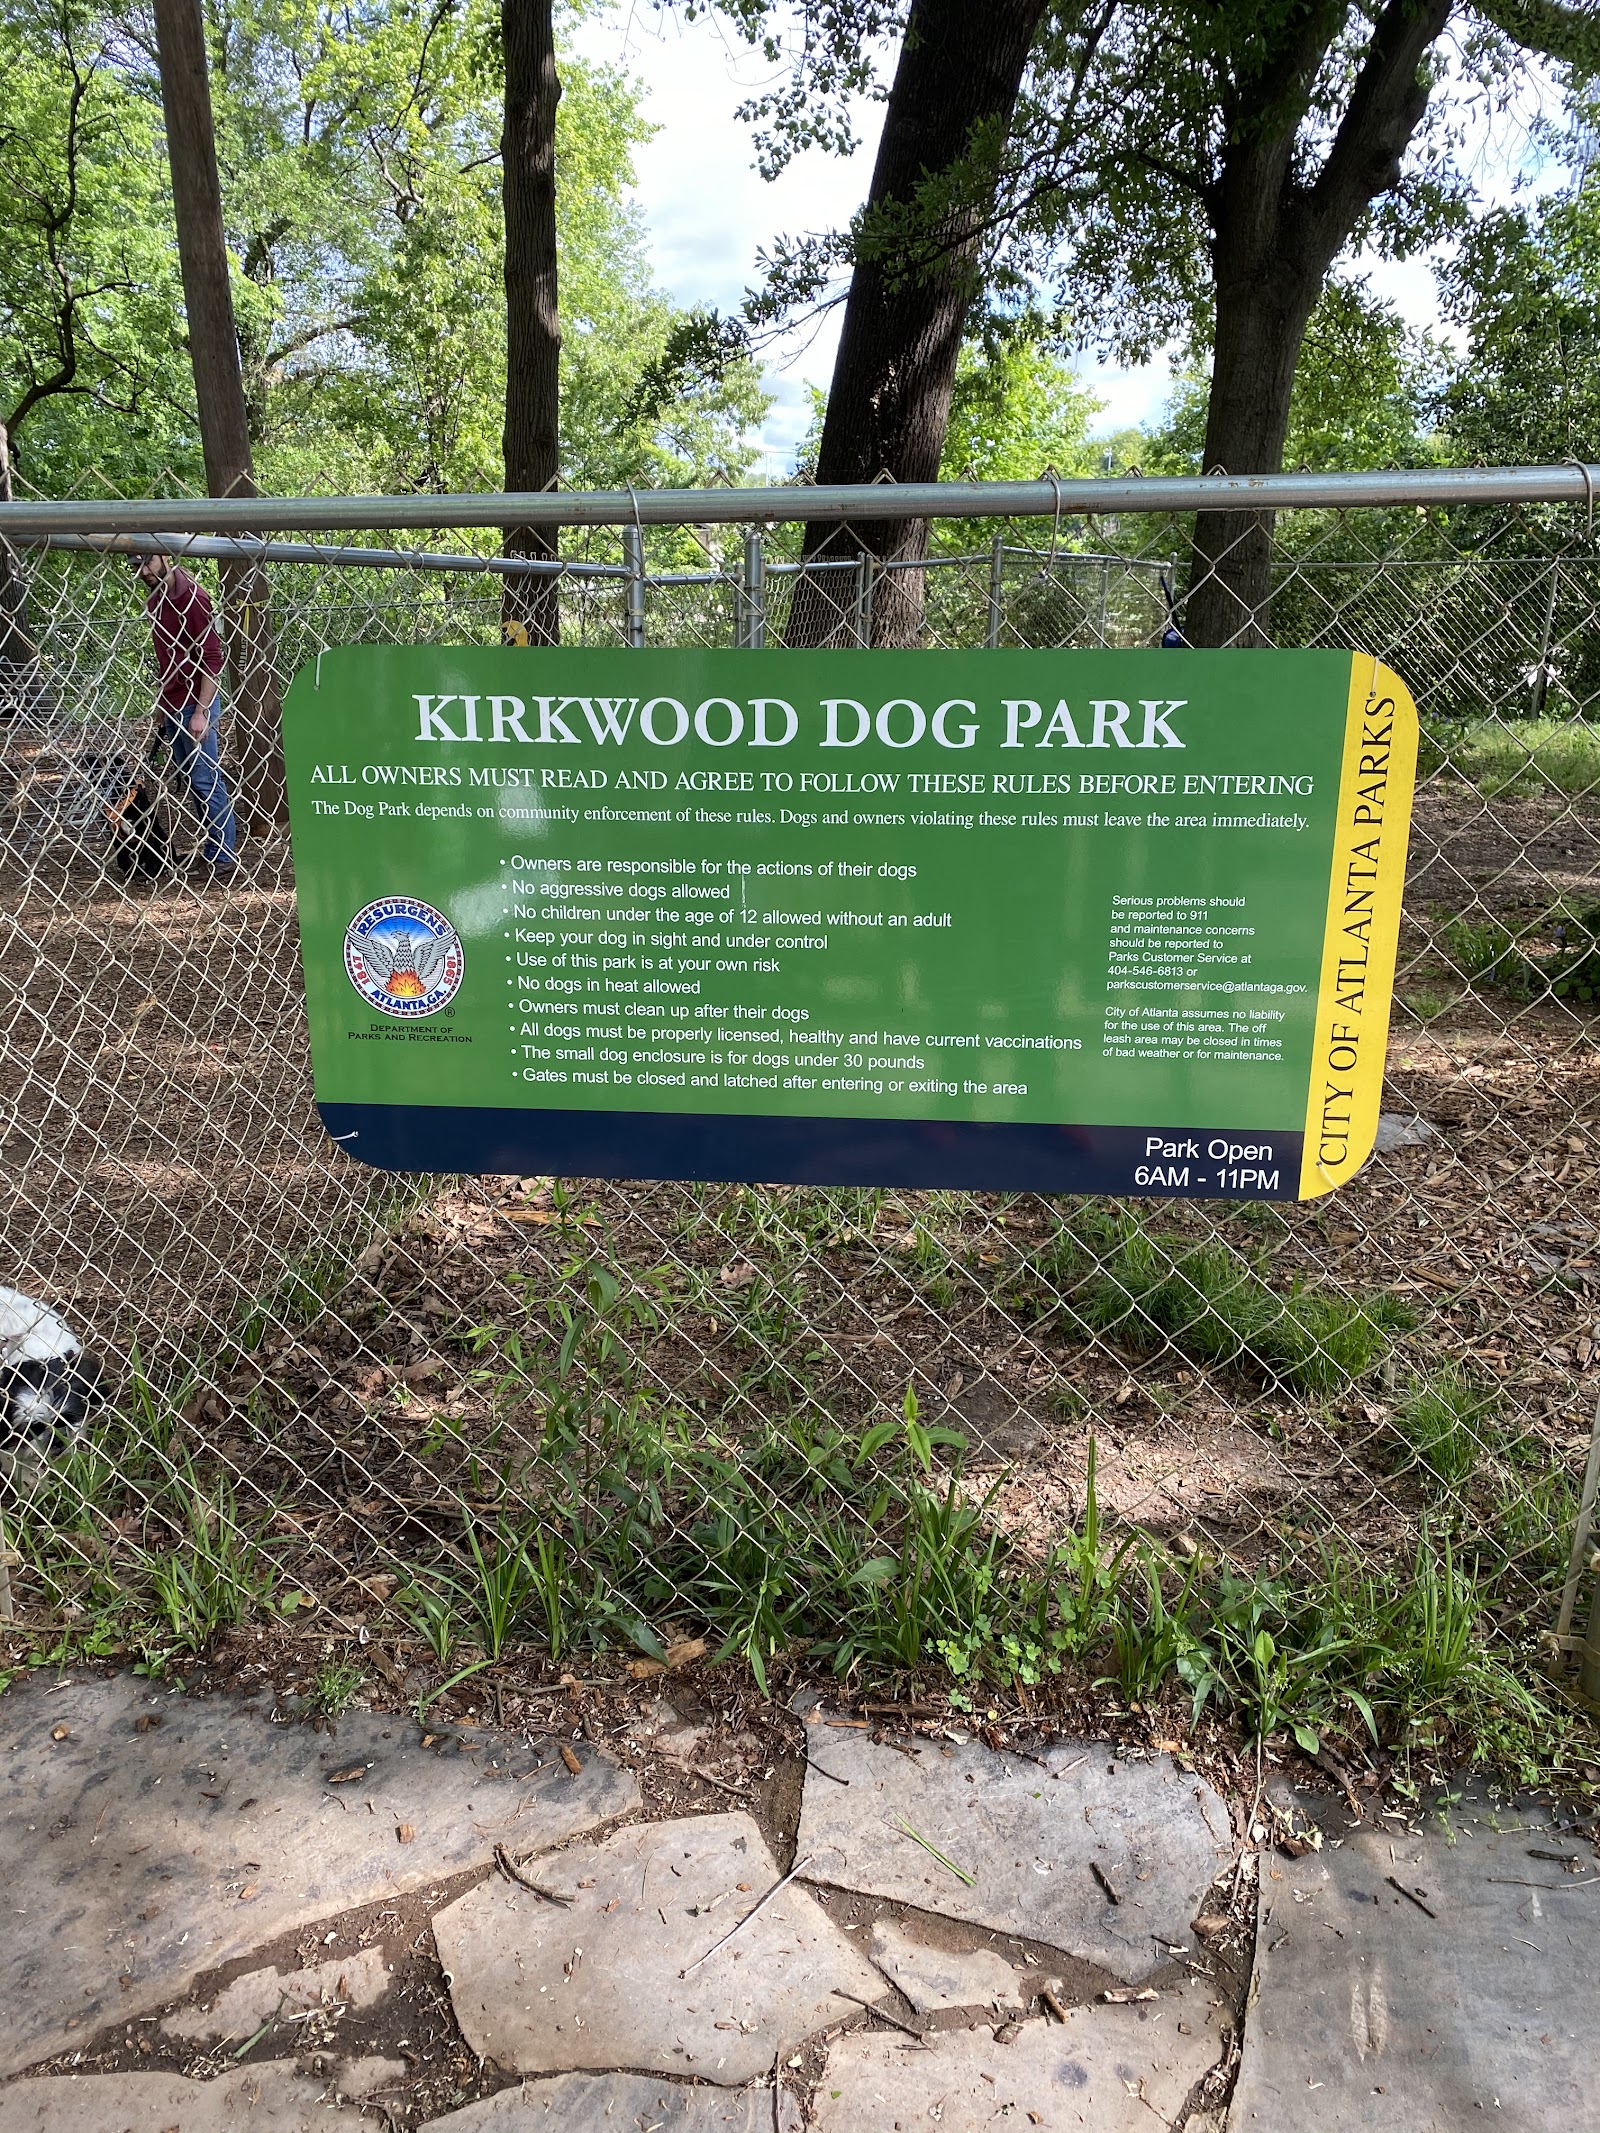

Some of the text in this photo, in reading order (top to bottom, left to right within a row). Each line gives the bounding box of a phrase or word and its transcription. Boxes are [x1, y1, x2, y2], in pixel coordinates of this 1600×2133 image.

[411, 694, 1188, 748] KIRKWOOD DOG PARK
[310, 765, 1314, 795] ALL OWNERS MUST READ AND AGREE TO FOLLOW THESE RULES BEFORE ENTERING
[311, 800, 1309, 831] The Dog Park depends on community enforcement of these rules. Dogs and owners violating these rules must leave the area immediately.
[511, 855, 916, 880] Owners are responsible for the actions of their dogs
[512, 879, 729, 901] No aggressive dogs allowed
[1112, 895, 1245, 907] Serious problems should
[357, 904, 447, 936] RESURGENS
[513, 904, 951, 927] No children under the age of 12 allowed without an adult
[1111, 909, 1207, 921] be reported to 911
[515, 928, 827, 949] Keep your dog in sight and under control
[1110, 923, 1255, 935] and maintenance concerns
[1319, 697, 1396, 1166] CITY OF ATLANTA PARKS
[516, 952, 780, 973] Use of this park is at your own risk
[1108, 951, 1251, 963] Parks Customer Service at
[1107, 965, 1198, 976] 404-546-6813 or
[1106, 979, 1307, 994] parkscustomerservice@atlantaga.gov.
[1105, 1006, 1126, 1018] City
[1128, 1006, 1139, 1016] of
[1141, 1007, 1178, 1017] Atlanta
[1181, 1010, 1229, 1018] assumes
[1249, 1009, 1285, 1021] liability
[520, 1022, 1082, 1049] All dogs must be properly licensed, healthy and have current vaccinations
[521, 1045, 924, 1070] The small dog enclosure is for dogs under 30 pounds
[522, 1067, 1027, 1096] Gates must be closed and latched after entering or exiting the area
[1146, 1137, 1272, 1164] Park Open
[1134, 1165, 1189, 1186] 6AM
[1216, 1168, 1279, 1189] 11PM
